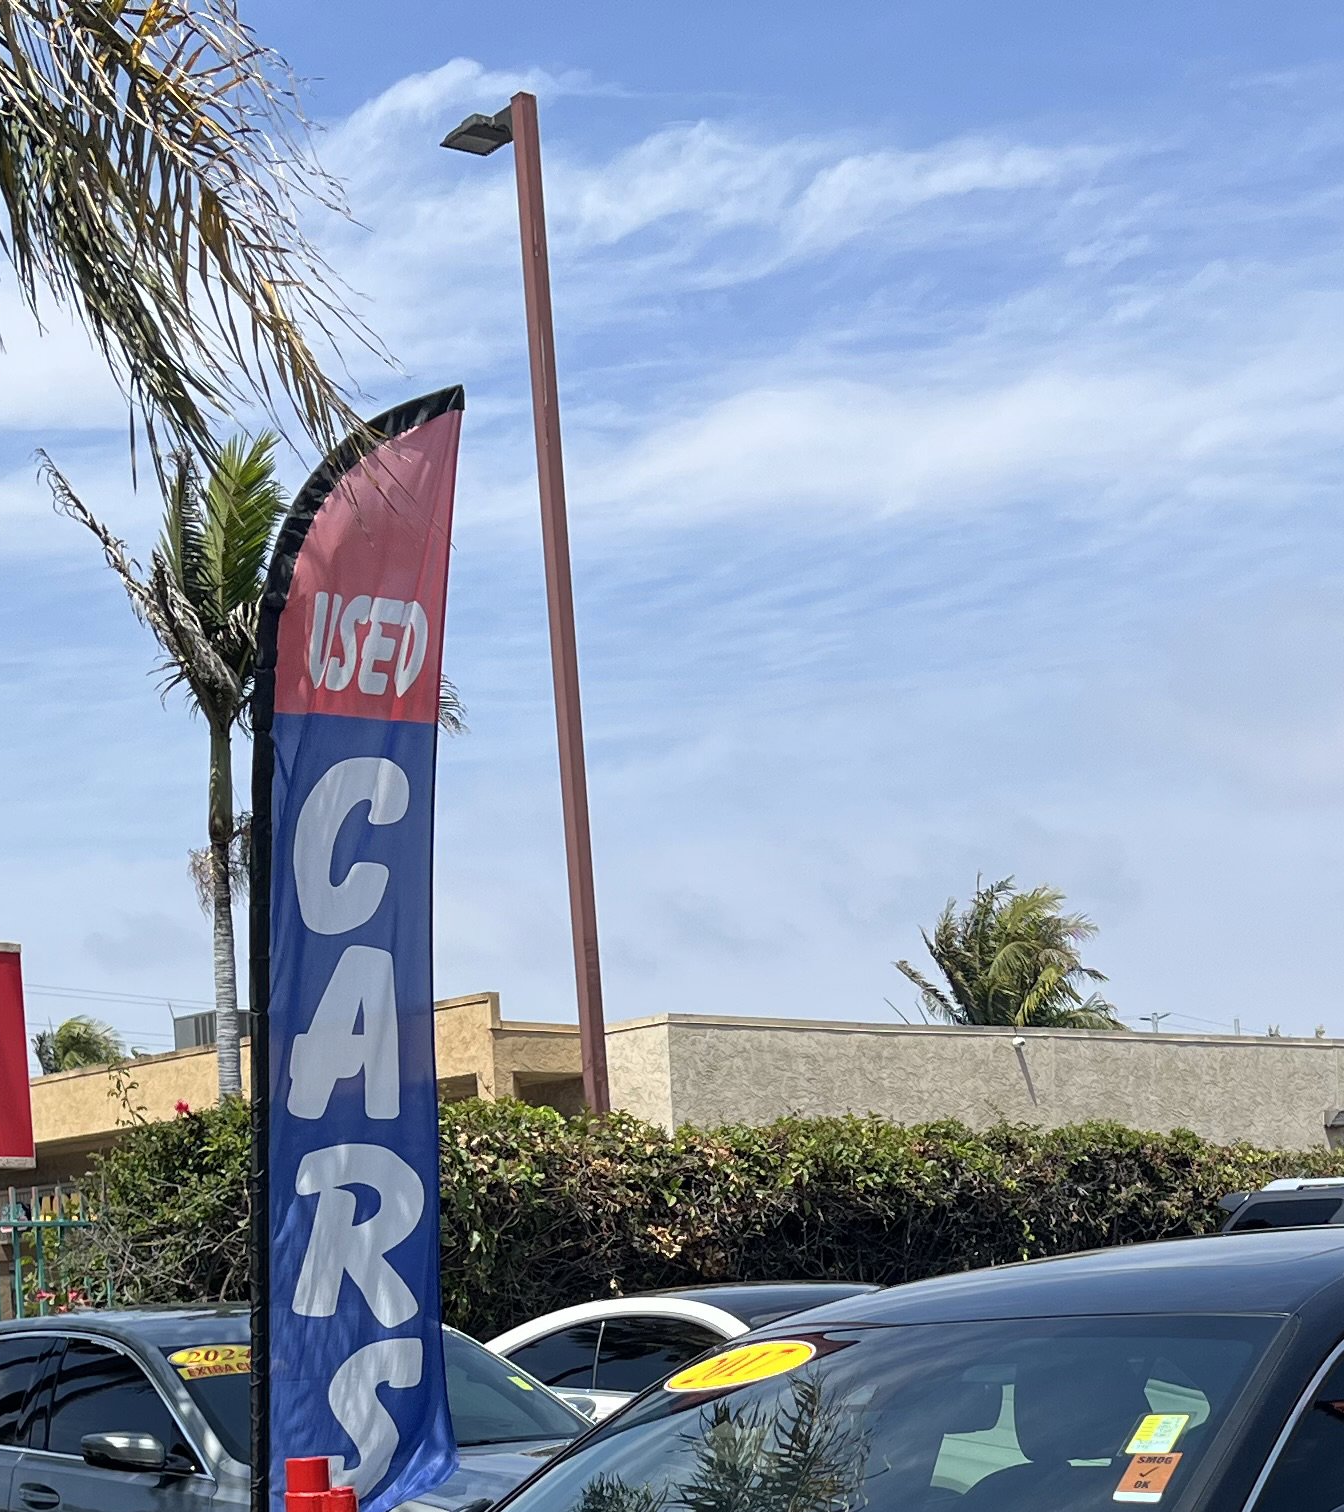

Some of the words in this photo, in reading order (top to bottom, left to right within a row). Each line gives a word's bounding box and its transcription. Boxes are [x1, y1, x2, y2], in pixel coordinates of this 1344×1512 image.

[309, 591, 429, 698] USED
[287, 757, 424, 1500] CARS
[1133, 1480, 1151, 1489] OK
[1137, 1456, 1173, 1465] SMOG
